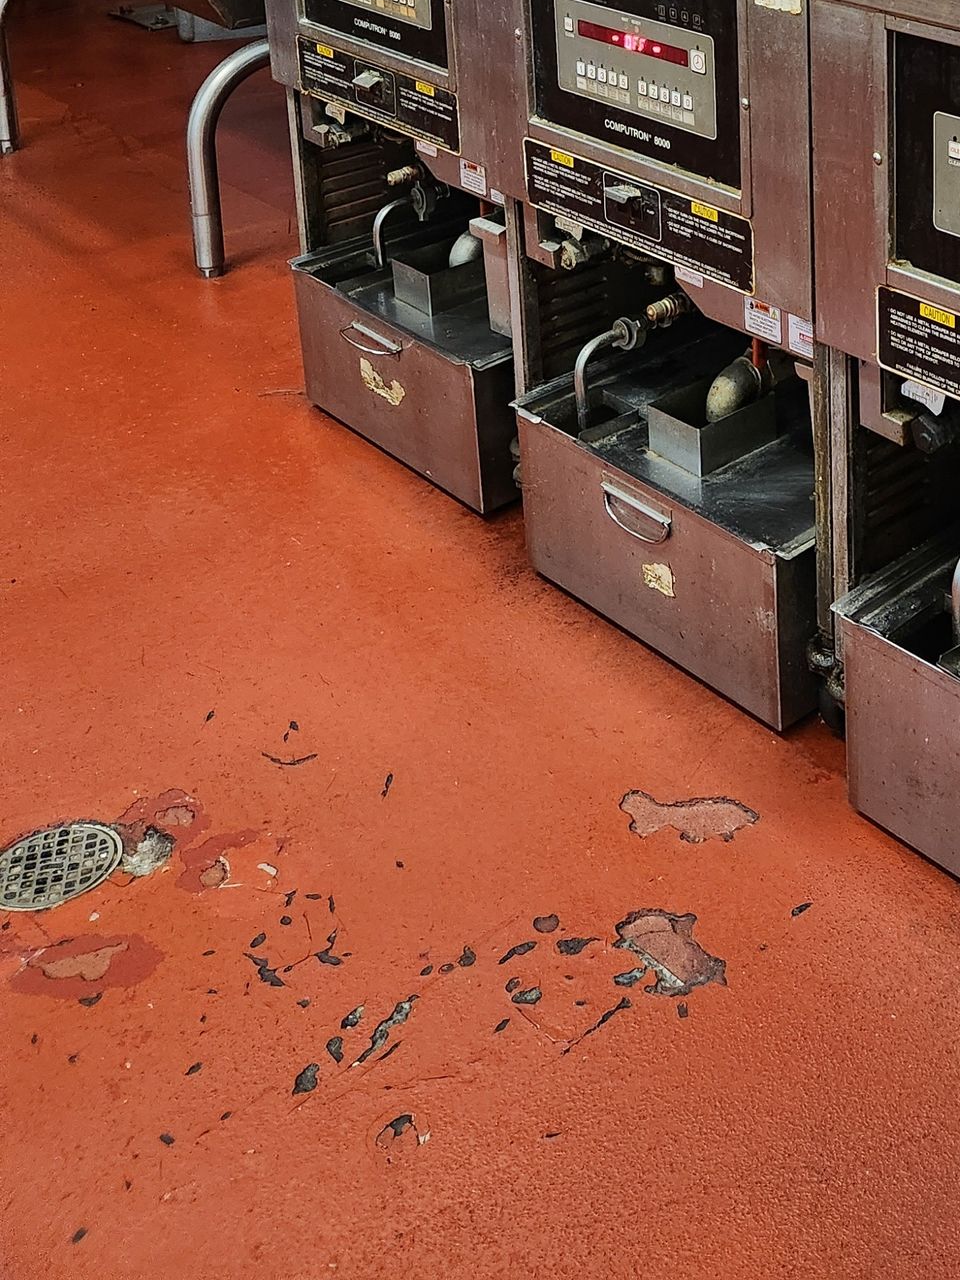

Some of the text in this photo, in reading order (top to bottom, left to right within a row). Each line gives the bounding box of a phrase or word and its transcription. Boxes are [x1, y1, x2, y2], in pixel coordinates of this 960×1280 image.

[354, 18, 400, 40] COMPUTRON 8000
[604, 119, 671, 149] COMPUTRON 8000
[553, 151, 573, 166] CAUTION
[693, 203, 715, 220] CAUTION
[924, 306, 950, 324] CAUTION
